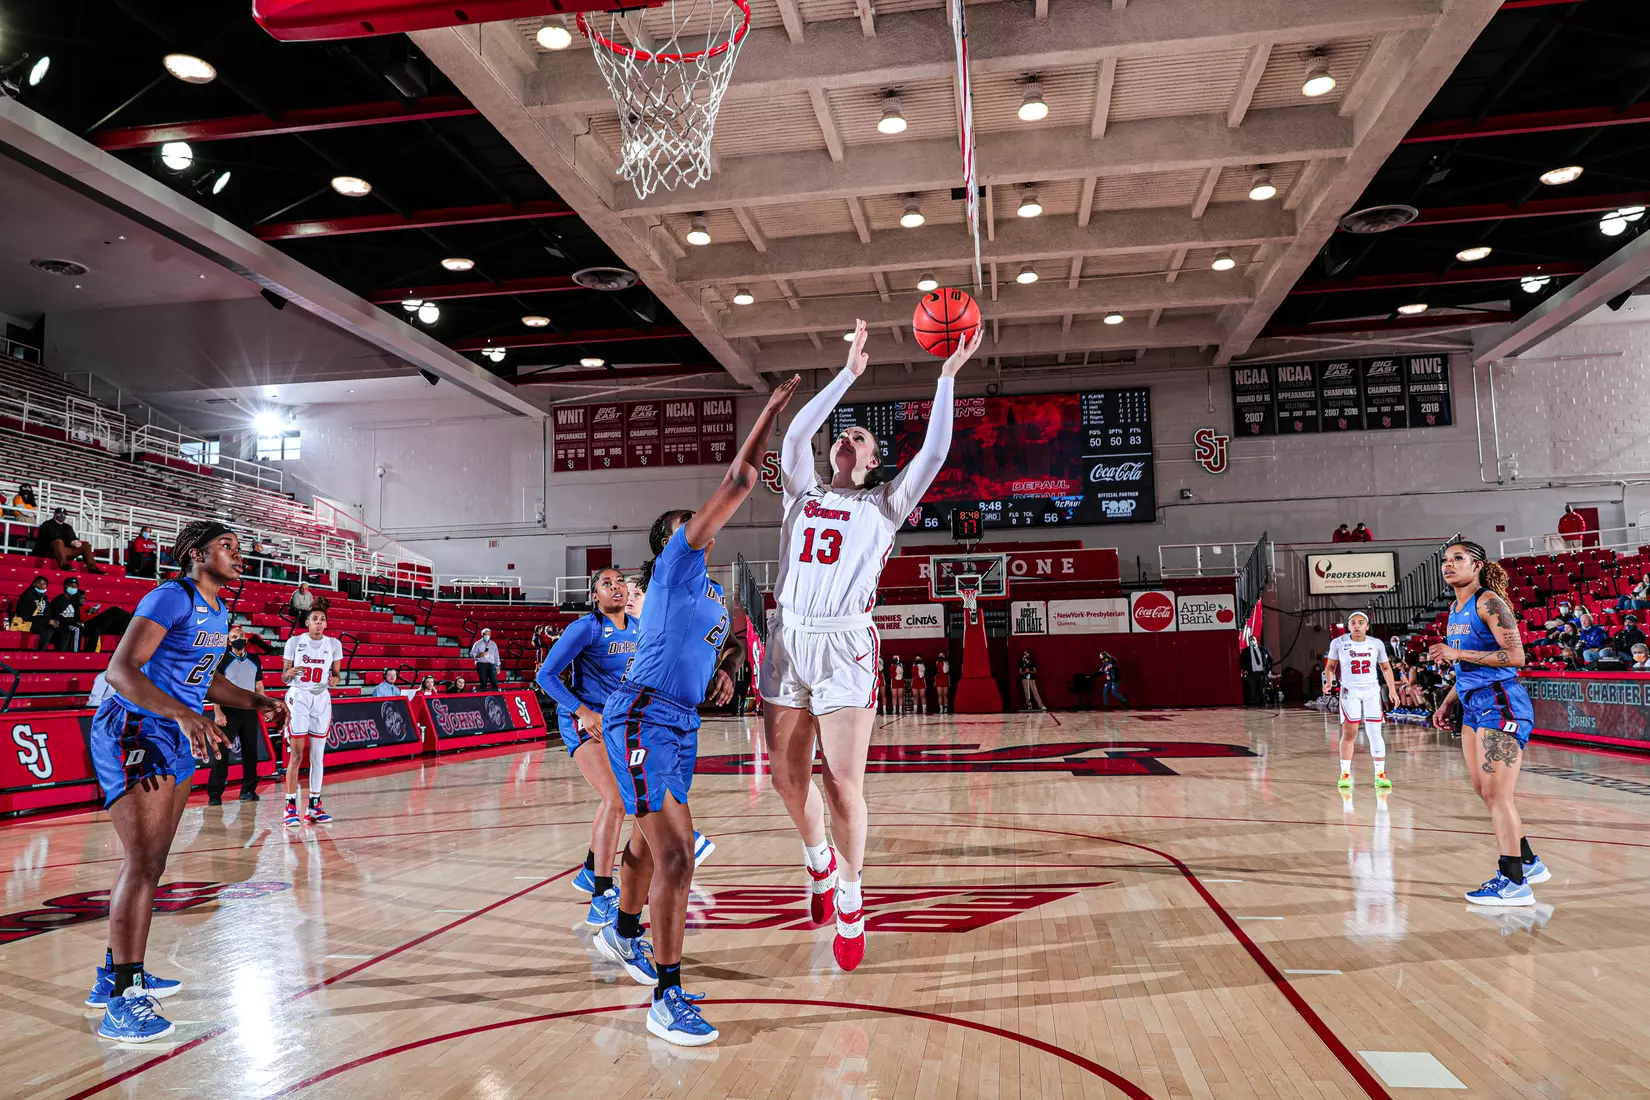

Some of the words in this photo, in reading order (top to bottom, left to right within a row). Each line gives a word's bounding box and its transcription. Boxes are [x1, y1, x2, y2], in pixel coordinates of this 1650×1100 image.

[1411, 357, 1442, 374] NIVC
[1235, 368, 1268, 385] NCAA
[1278, 366, 1312, 382] NCAA
[1324, 387, 1357, 397] CHAMPIONS
[1367, 385, 1401, 394] CHAMPIONS
[1409, 383, 1448, 392] APPEARANCES
[1236, 395, 1255, 403] ROUND
[1256, 394, 1263, 402] OF
[1264, 394, 1271, 402] 16
[1278, 391, 1315, 399] APPEARANCES
[666, 402, 695, 417] NCAA
[703, 400, 732, 415] NCAA
[1325, 409, 1340, 417] 2007
[1421, 403, 1439, 413] 2018
[557, 409, 584, 424] WNIT
[1245, 413, 1264, 422] 2007
[630, 429, 658, 437] CHAMPIONS
[665, 426, 696, 434] APPEARANCES
[702, 424, 723, 433] SWEET
[725, 423, 734, 432] 16
[555, 432, 586, 440] APPEARANCES
[594, 431, 622, 439] CHAMPIONS
[711, 442, 726, 451] 2012
[1090, 438, 1102, 447] 50
[1110, 437, 1122, 446] 50
[1129, 435, 1142, 445] 83
[594, 448, 606, 456] 1983
[609, 447, 622, 455] 1985
[1090, 461, 1145, 482] Coca-Cola
[1012, 480, 1070, 491] DEPAUL
[979, 501, 1002, 512] 8:48
[1101, 499, 1137, 512] FOOD
[959, 511, 980, 520] 8:48
[984, 513, 998, 521] 3RD
[1026, 517, 1031, 525] 3
[1044, 513, 1059, 523] 56
[924, 518, 939, 528] 56
[964, 519, 977, 534] 17
[799, 527, 843, 565] 13
[919, 561, 978, 579] RED
[1326, 571, 1387, 579] PROFESSIONAL
[1020, 607, 1037, 617] ACCEPT
[1135, 607, 1171, 619] Coca-Cola
[1180, 602, 1217, 615] Apple
[1056, 609, 1125, 620] NewYork-Presbyterian
[1180, 613, 1214, 625] Bank
[886, 622, 902, 630] HERE.
[1016, 617, 1026, 632] NO
[1027, 616, 1043, 632] HATE
[1351, 660, 1371, 675] 22
[300, 667, 323, 684] 30
[1540, 681, 1584, 702] OFFICIAL
[1586, 682, 1642, 706] CHARTER
[443, 711, 484, 737] JOHN'S
[1502, 720, 1519, 734] D
[326, 718, 380, 750] JOHN'S
[124, 749, 147, 767] D
[628, 747, 649, 768] D
